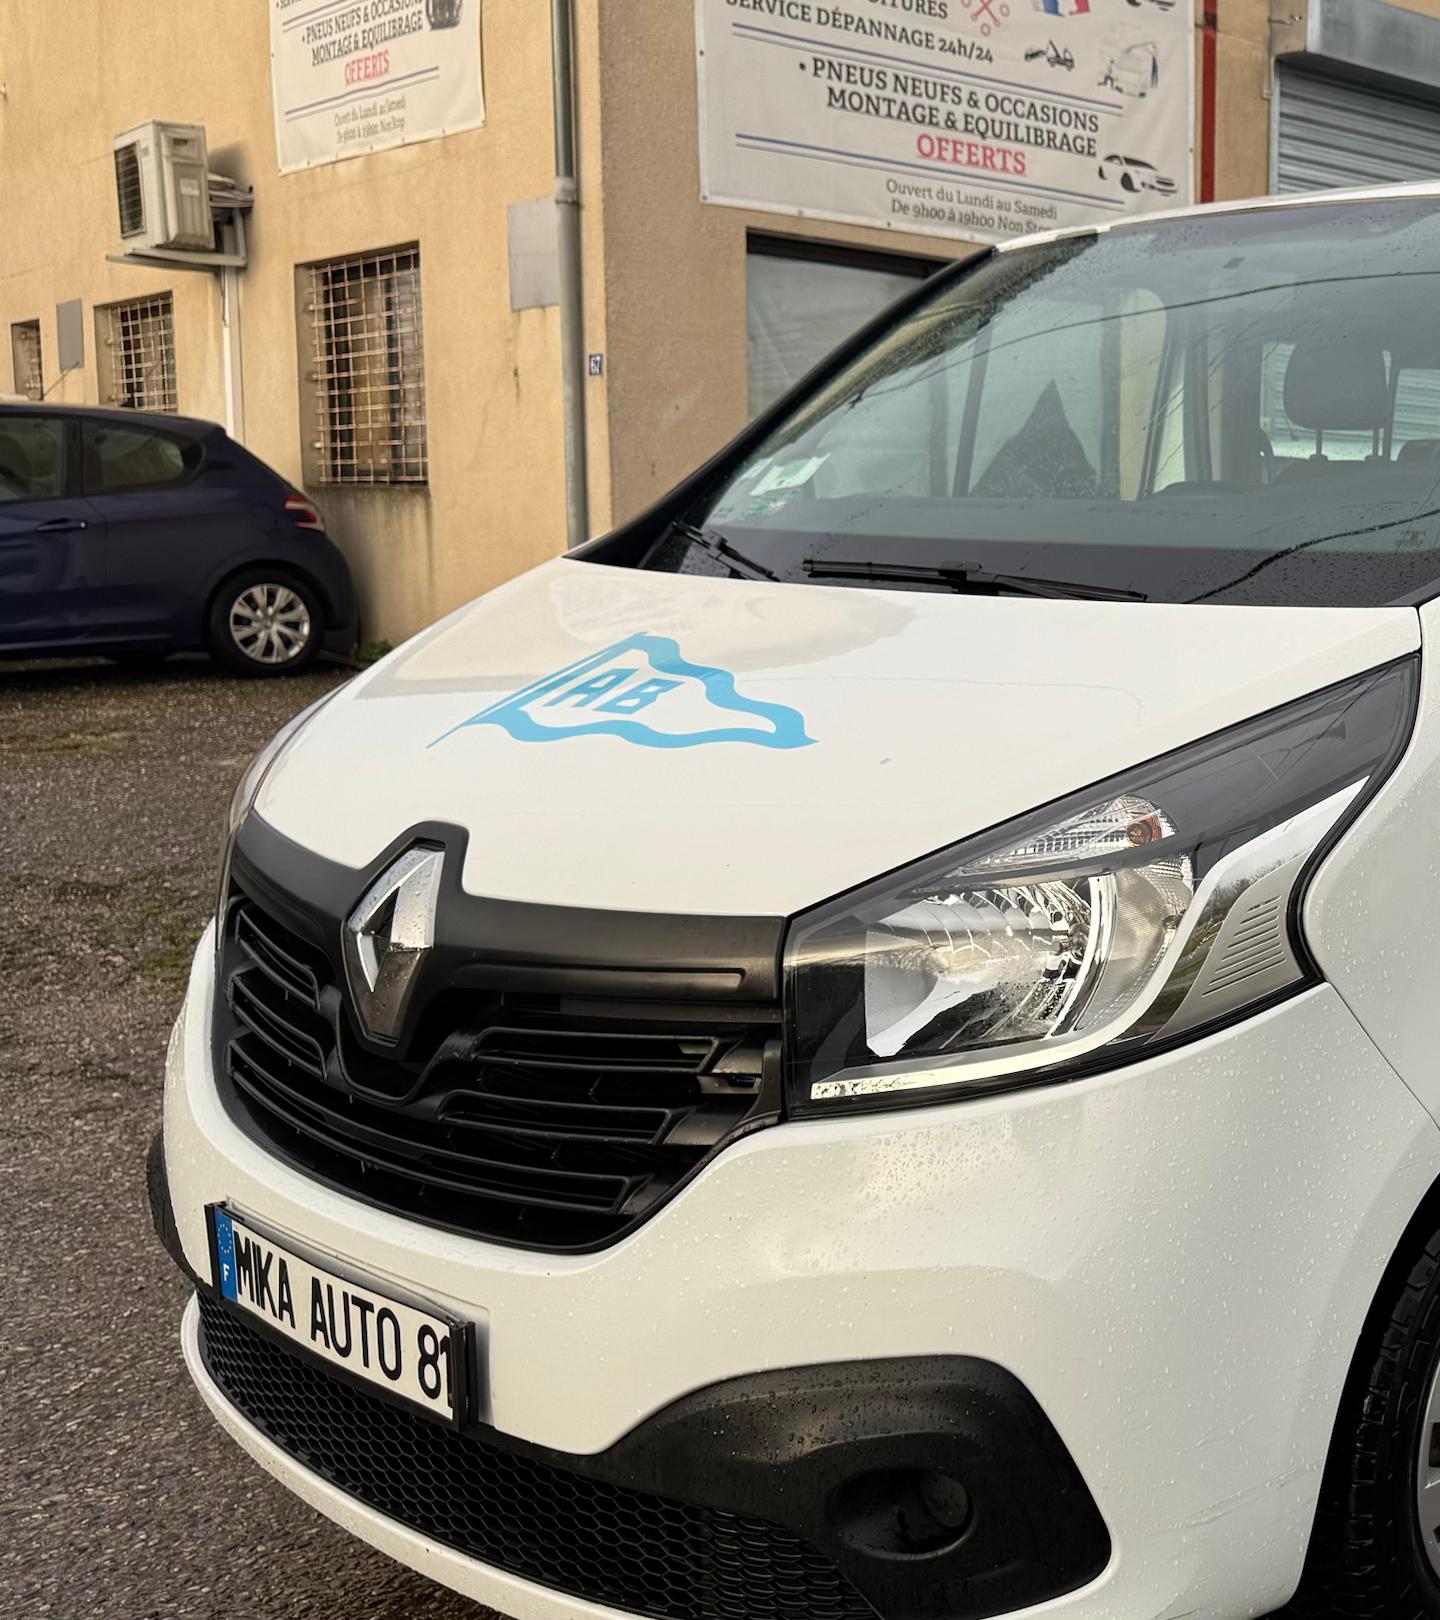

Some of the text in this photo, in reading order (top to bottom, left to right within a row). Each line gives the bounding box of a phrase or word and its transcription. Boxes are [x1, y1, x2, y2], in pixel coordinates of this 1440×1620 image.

[307, 17, 333, 45] PNEUS
[335, 6, 361, 34] NEUFS
[371, 0, 422, 20] OCCASI
[867, 0, 948, 19] URES
[312, 34, 352, 66] MONTAGE
[362, 10, 423, 50] EQUILIBRAGE
[817, 6, 935, 50] DÉPANNAGE
[938, 38, 994, 64] 24h/24
[344, 50, 390, 85] OFFERTS
[812, 57, 1099, 132] PNEUS NEUFS & OCCASIONS
[827, 87, 1097, 156] MONTAGE & EQUILIBRAGE
[916, 134, 1027, 174] OFFERTS
[886, 178, 1058, 220] Ouvert du Lundi au Samedi
[891, 199, 1054, 234] De 9h00 à 19h00 Non Sto
[543, 668, 685, 715] AB
[223, 1263, 229, 1282] F
[234, 1230, 453, 1408] MIKA AUTO 81
